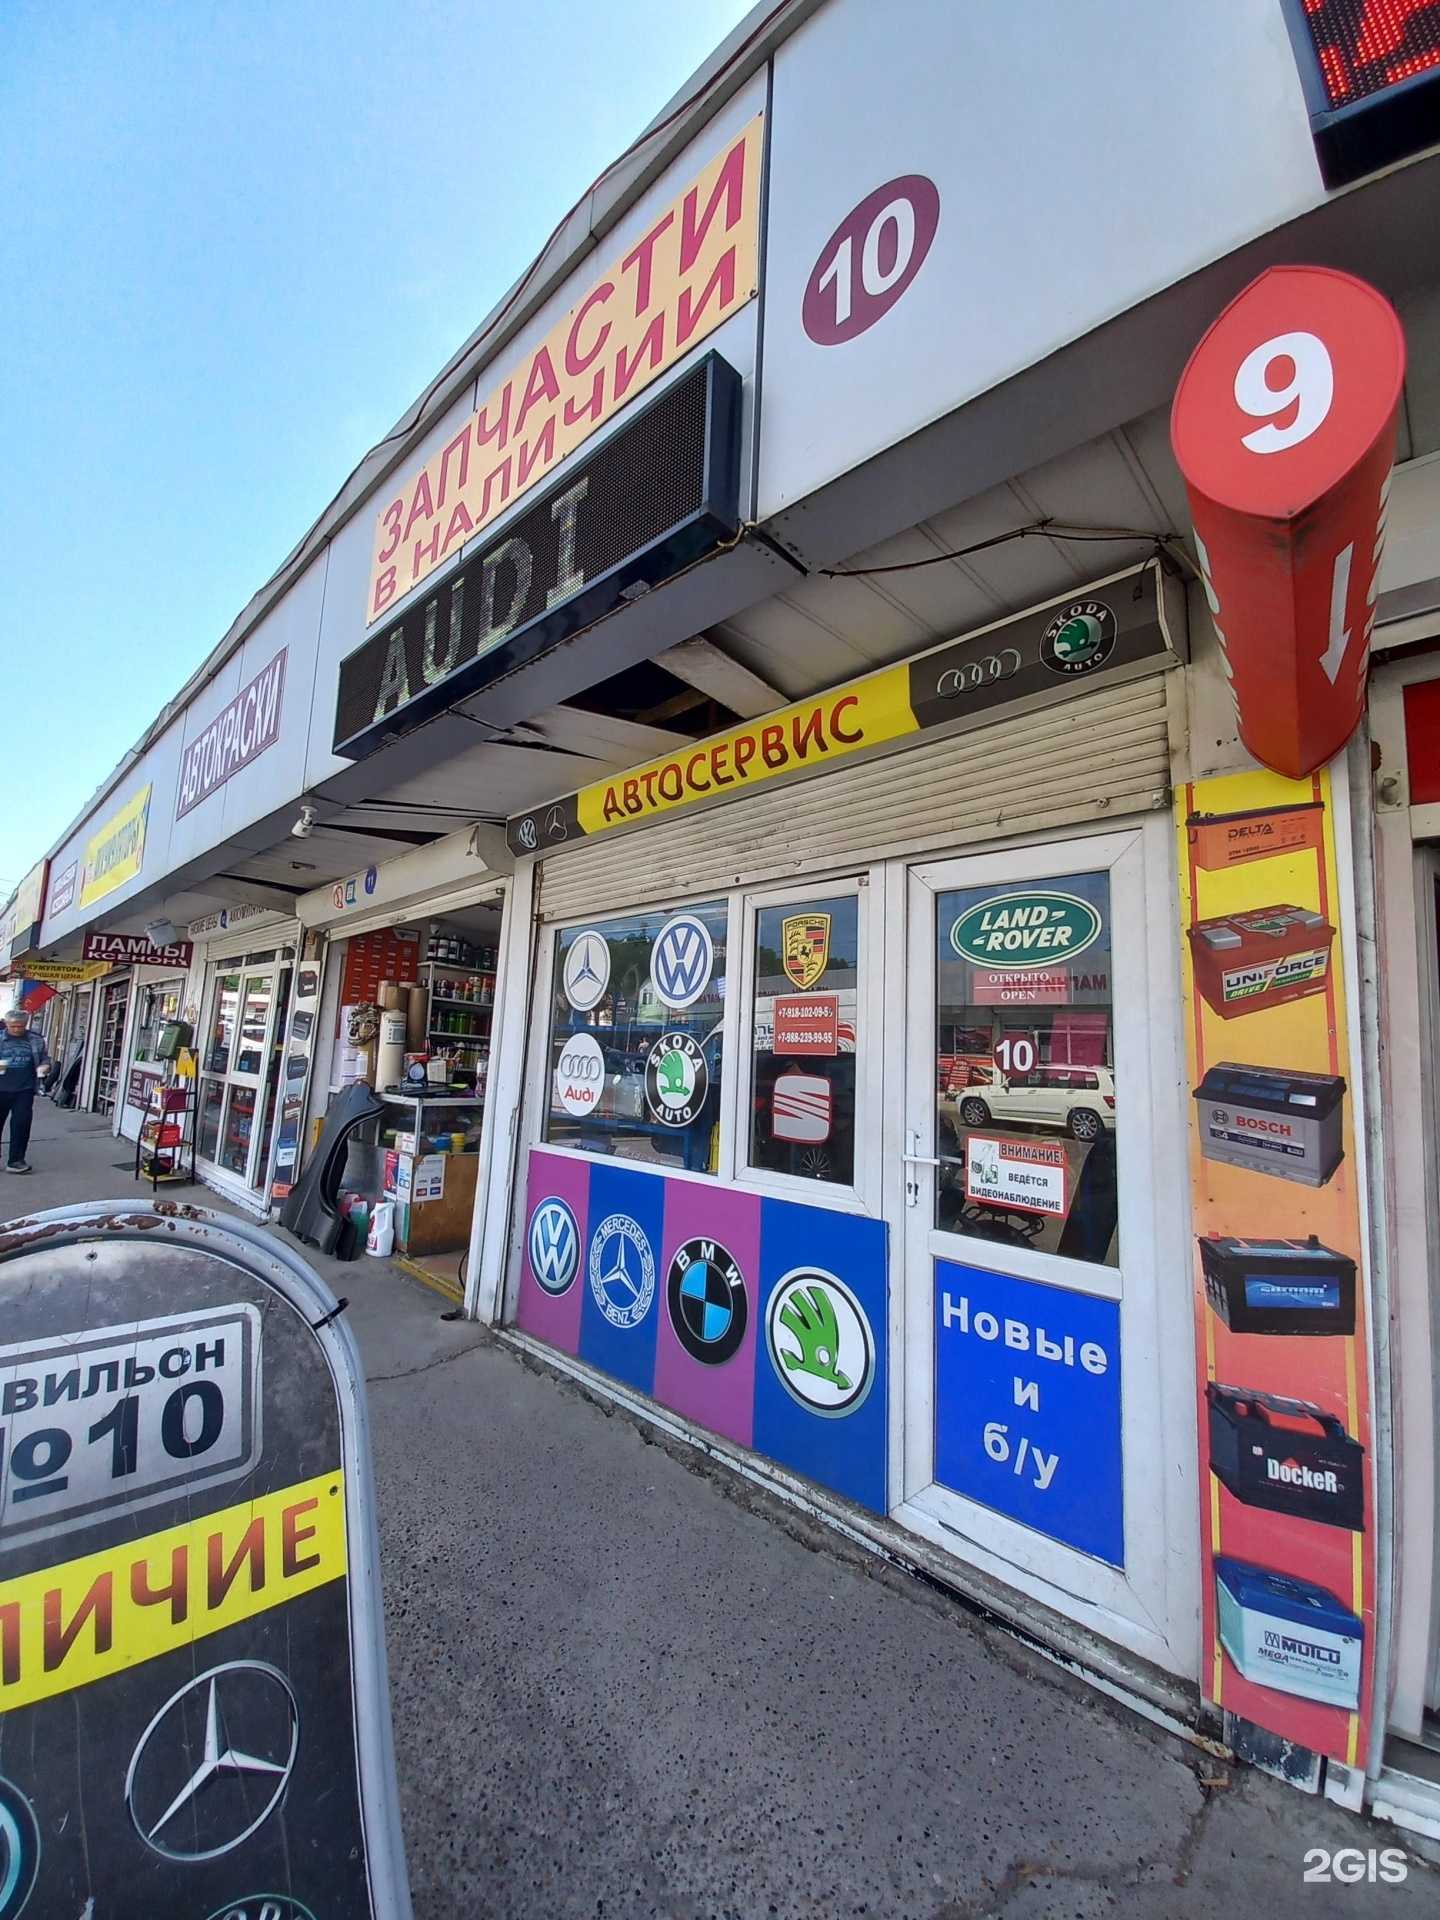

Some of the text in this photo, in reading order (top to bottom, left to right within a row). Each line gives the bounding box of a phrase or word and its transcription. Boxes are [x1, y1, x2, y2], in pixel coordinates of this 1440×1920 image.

[818, 198, 916, 326] 10
[378, 137, 746, 565] ЗАПЧАСТИ
[1233, 331, 1334, 454] 9
[372, 246, 736, 616] В НАЛИЧИИ
[371, 475, 589, 724] AUDI
[1048, 603, 1107, 638] SKODA
[1064, 653, 1102, 671] AUTO
[180, 660, 281, 812] АВТОКРАСКИ
[602, 696, 865, 823] АВТОСЕРВИС
[1228, 823, 1275, 840] DELTA
[787, 919, 824, 929] PORSCHE
[989, 971, 1050, 984] ОТКРЫТО
[1001, 991, 1036, 1000] OPEN
[650, 1035, 703, 1073] SKODA
[996, 1040, 1034, 1072] 10
[564, 1085, 594, 1104] Audi
[656, 1106, 692, 1122] AUTO
[1236, 1115, 1291, 1136] BOSCH
[1001, 1143, 1064, 1164] ВНИМАНИЕ!
[970, 1185, 1061, 1210] ВИДЕОНАБЛЮДЕНИЕ
[601, 1217, 647, 1251] MERCEDES
[675, 1241, 742, 1289] BMW
[606, 1303, 631, 1325] BENZ
[943, 1292, 1109, 1375] Новые
[1013, 1376, 1040, 1413] и
[983, 1421, 1059, 1490] б/у
[1258, 1647, 1289, 1664] MEGA
